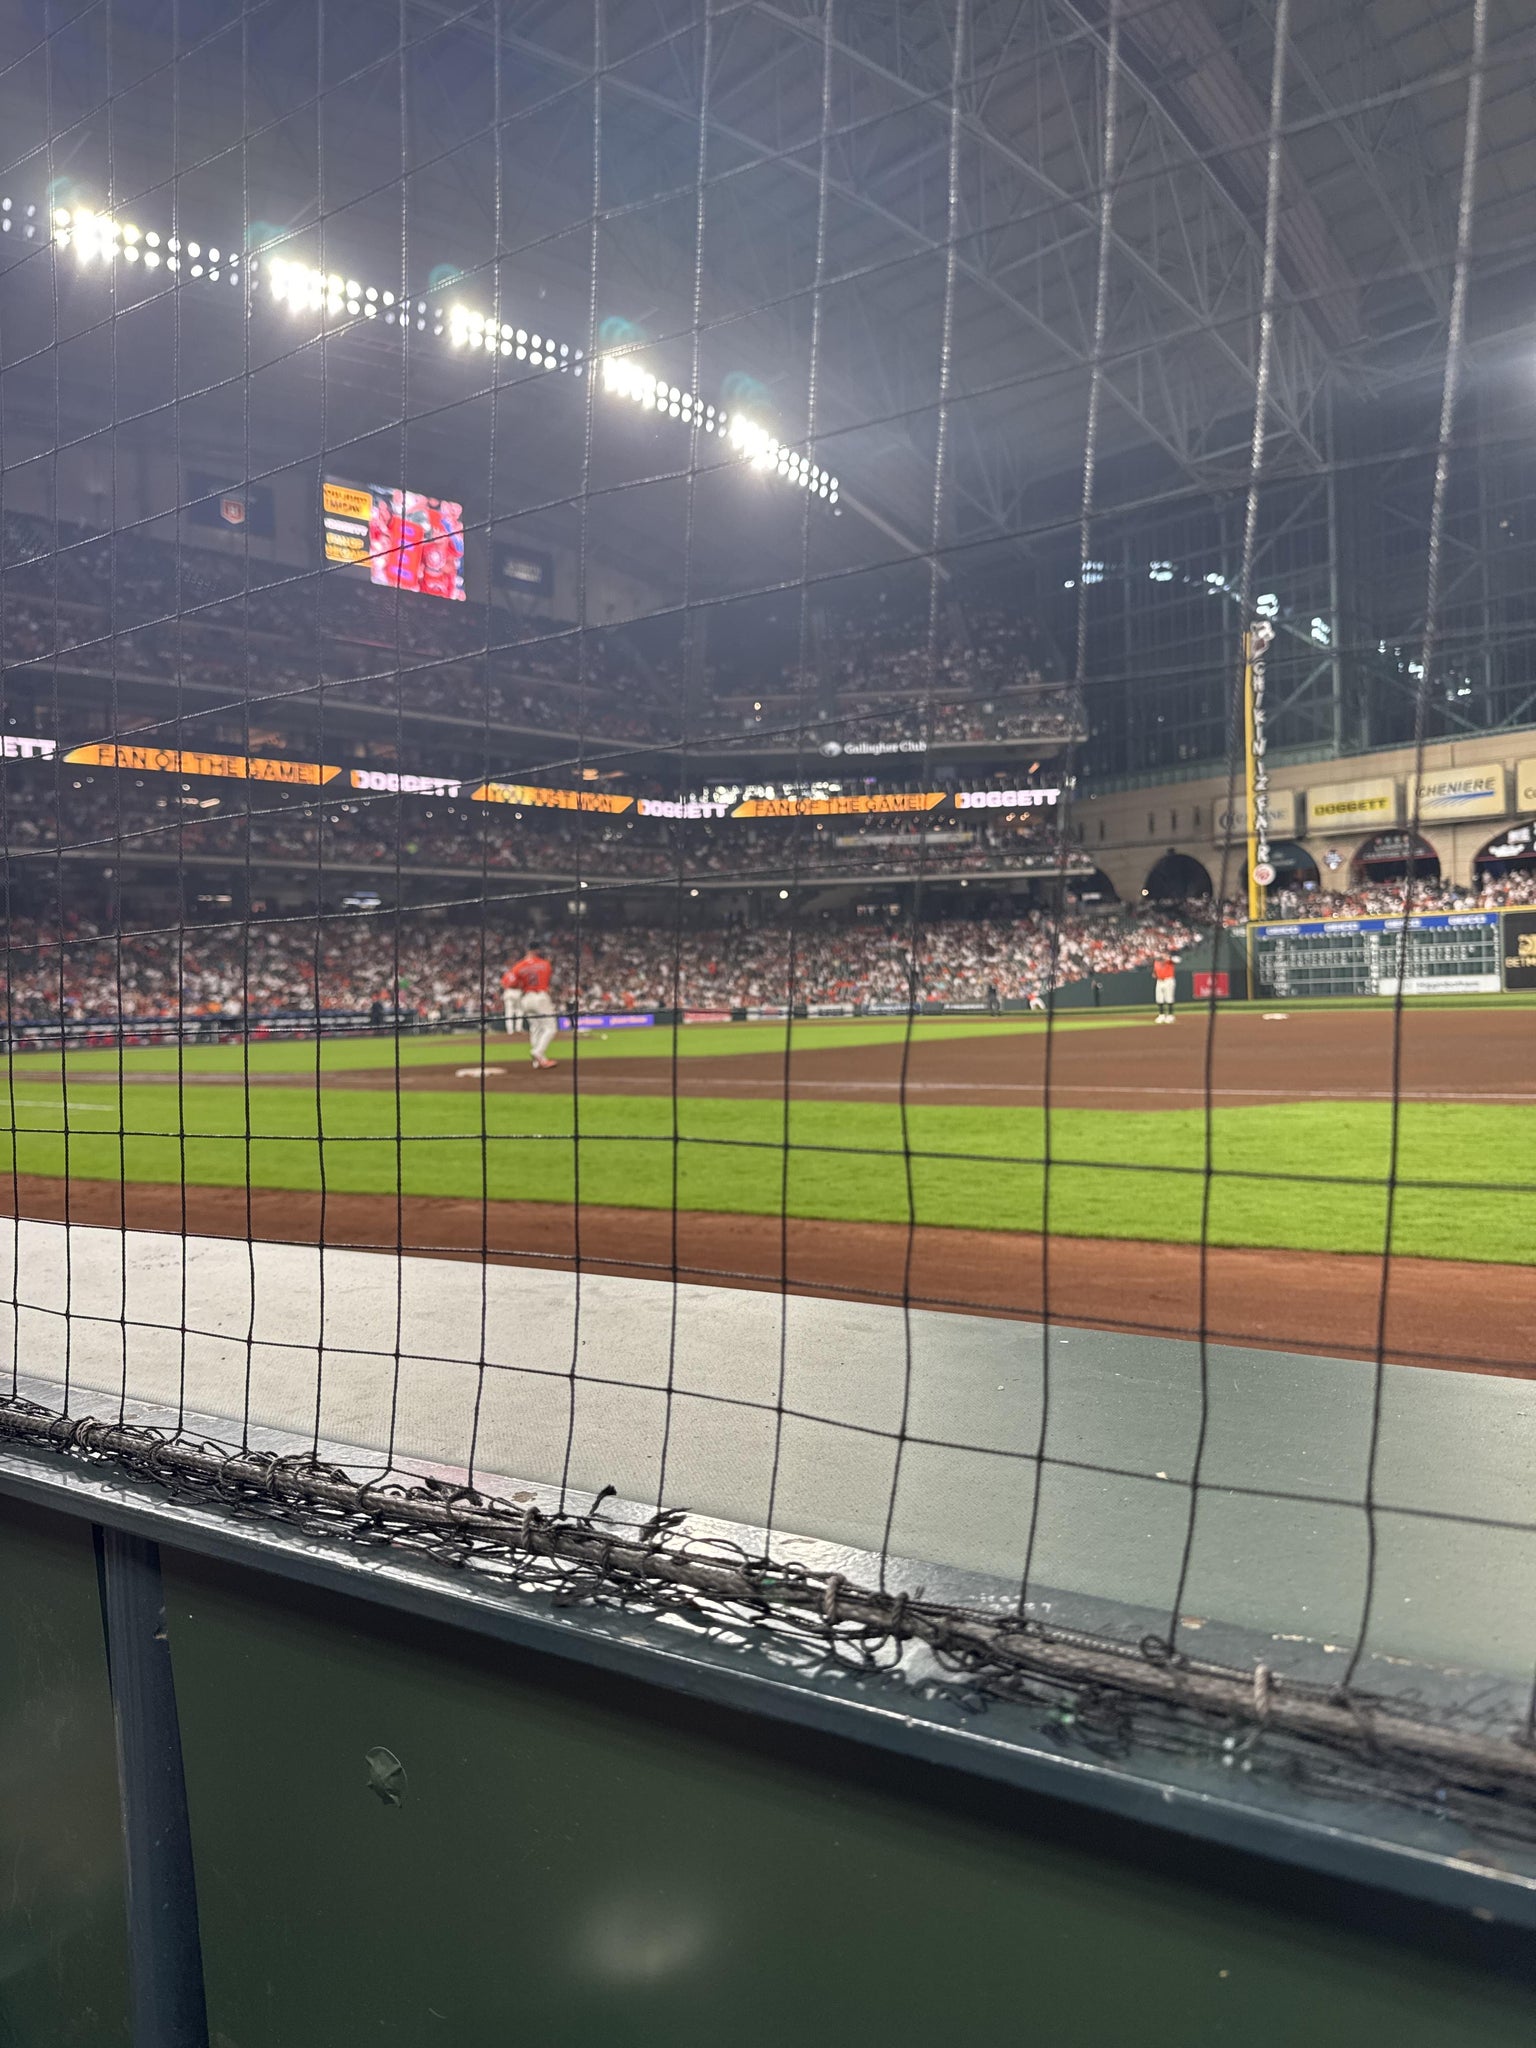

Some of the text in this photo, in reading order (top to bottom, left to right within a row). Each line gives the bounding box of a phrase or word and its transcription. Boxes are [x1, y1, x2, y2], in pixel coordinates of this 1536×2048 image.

[0, 735, 57, 760] ETT
[843, 740, 927, 756] Gallagher Club
[98, 747, 148, 769] FAN
[193, 753, 238, 777] THE
[1416, 777, 1495, 799] CHENIERE
[755, 800, 790, 817] FAN
[795, 799, 819, 816] OF
[825, 797, 860, 814] THE
[956, 789, 1060, 809] DOGGETT
[1315, 797, 1387, 817] DOGGETT
[1505, 956, 1536, 968] BETM
